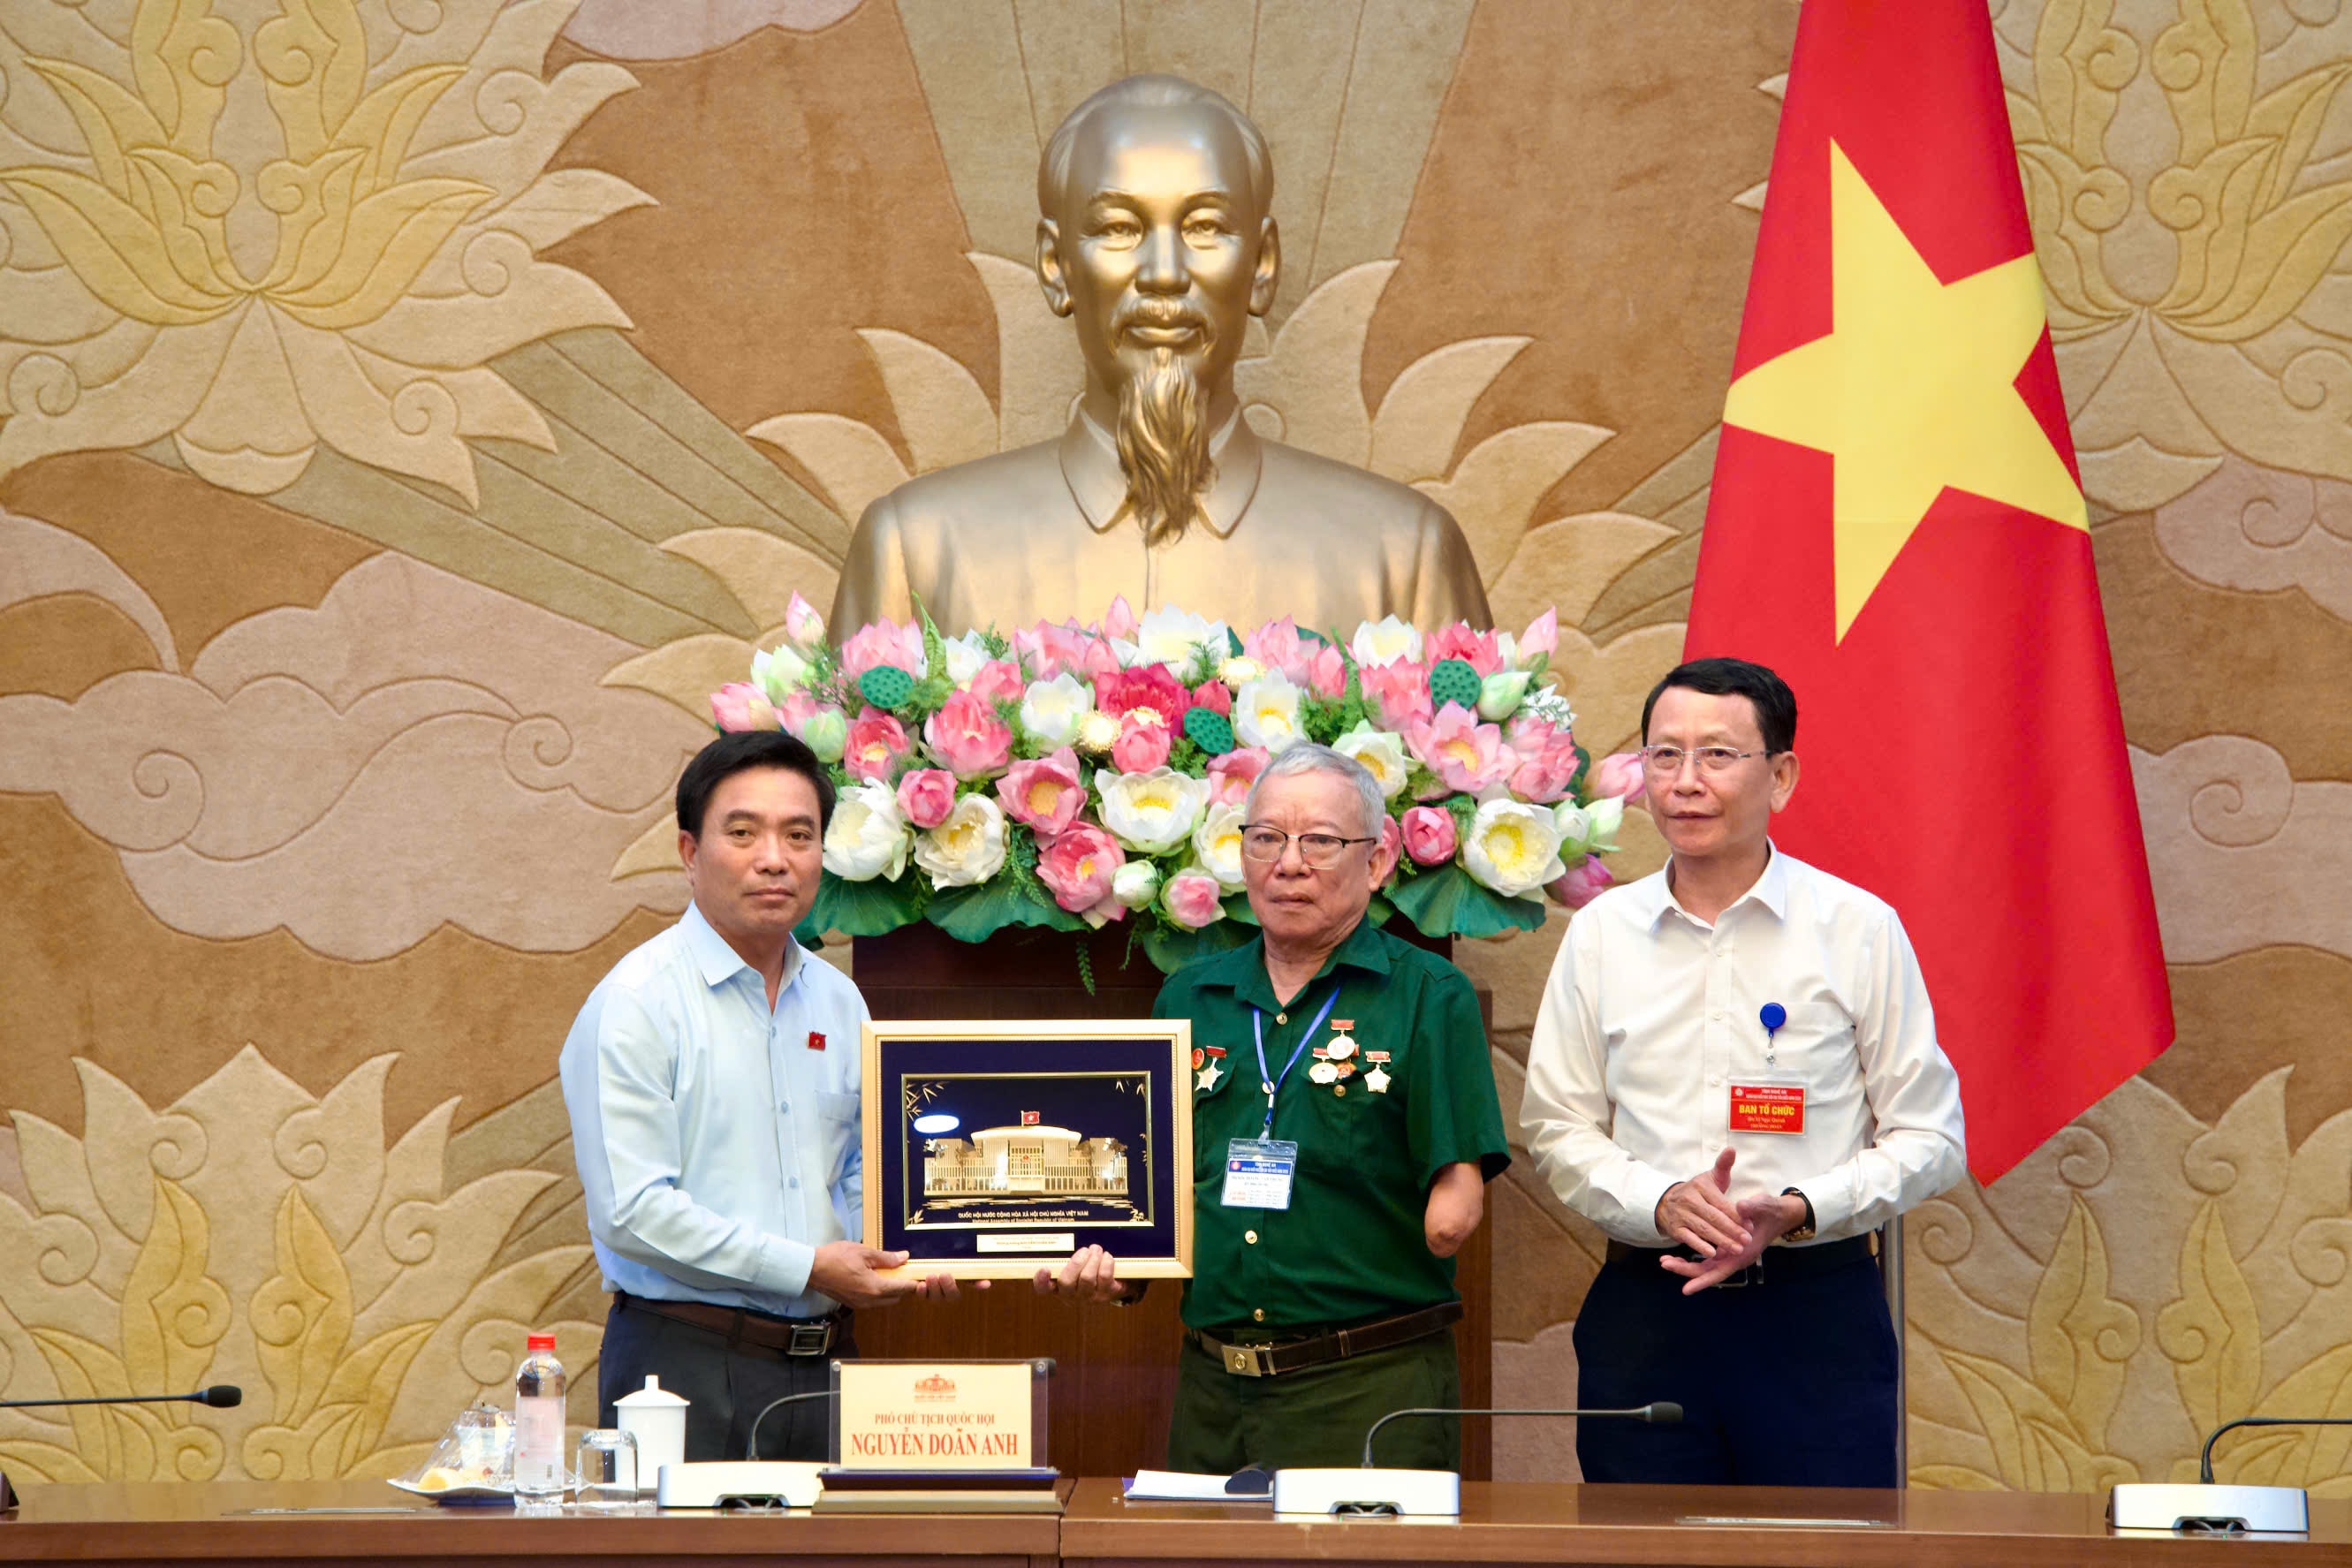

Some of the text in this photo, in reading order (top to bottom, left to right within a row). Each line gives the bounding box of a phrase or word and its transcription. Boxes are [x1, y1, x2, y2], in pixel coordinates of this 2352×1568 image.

[1739, 1102, 1795, 1116] BAN TỔ CHỨC
[875, 1411, 995, 1427] PHÓ CHỦ TỊCH QUỐC HỘI
[852, 1428, 1018, 1456] NGUYỄN DOÃN ANH
